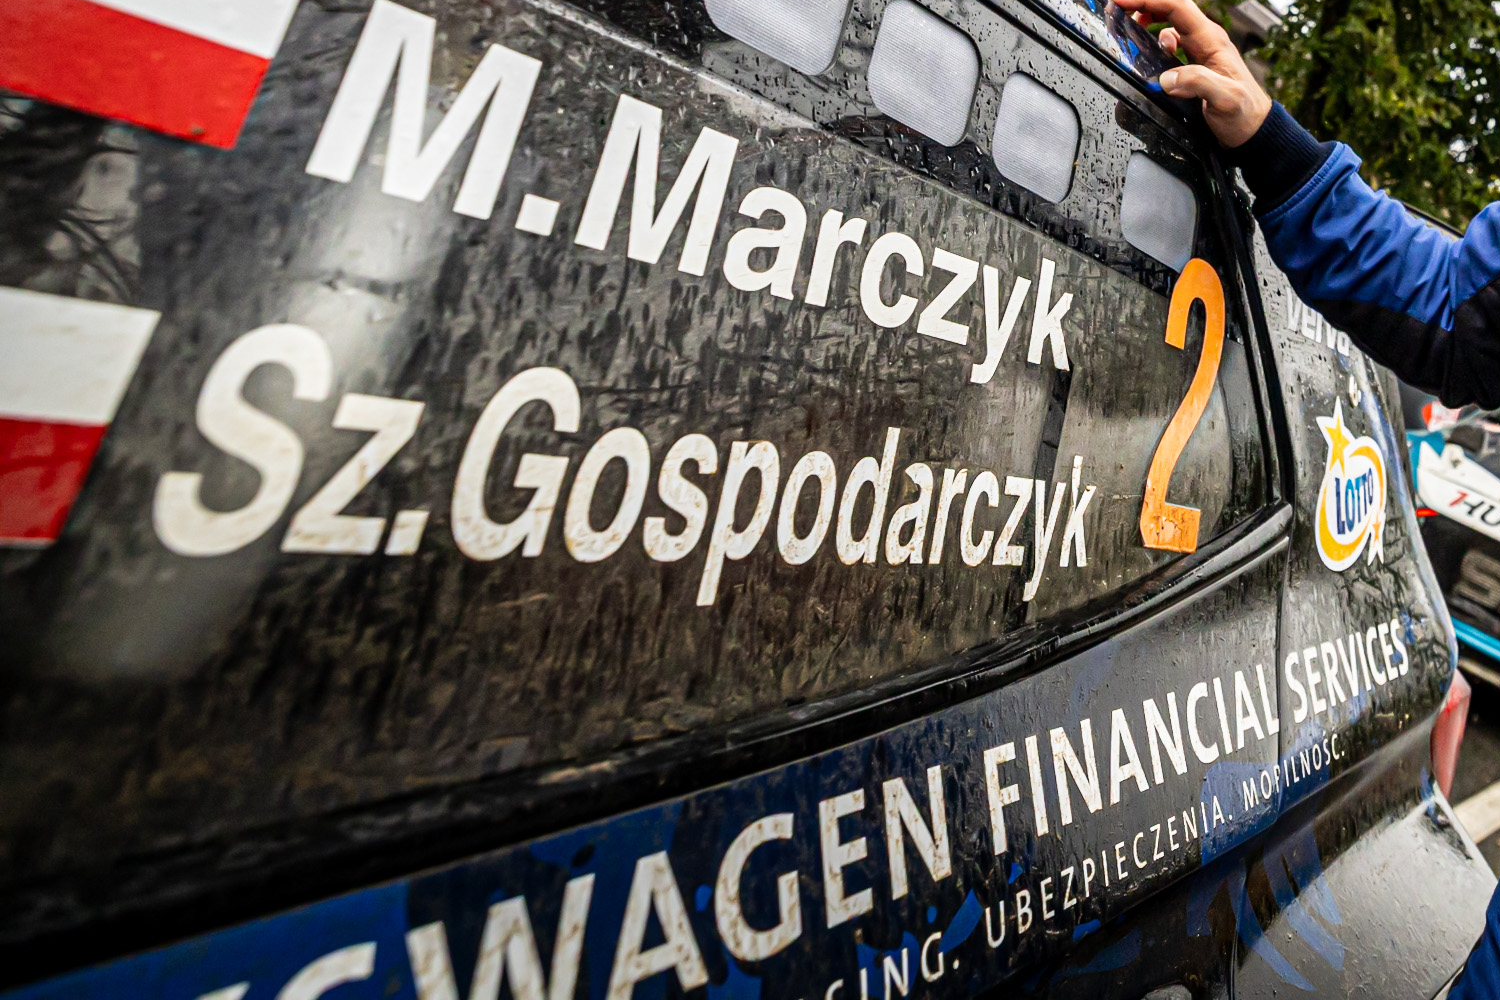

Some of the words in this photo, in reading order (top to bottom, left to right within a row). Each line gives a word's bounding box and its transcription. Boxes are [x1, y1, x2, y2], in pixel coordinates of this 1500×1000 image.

[1140, 258, 1225, 553] 2
[1335, 468, 1374, 535] LOTTO
[195, 766, 952, 1000] WAGEN
[982, 664, 1279, 856] FINANCIAL
[1284, 619, 1409, 726] SERVICES
[985, 796, 1233, 948] UBEZPIECZENIA.
